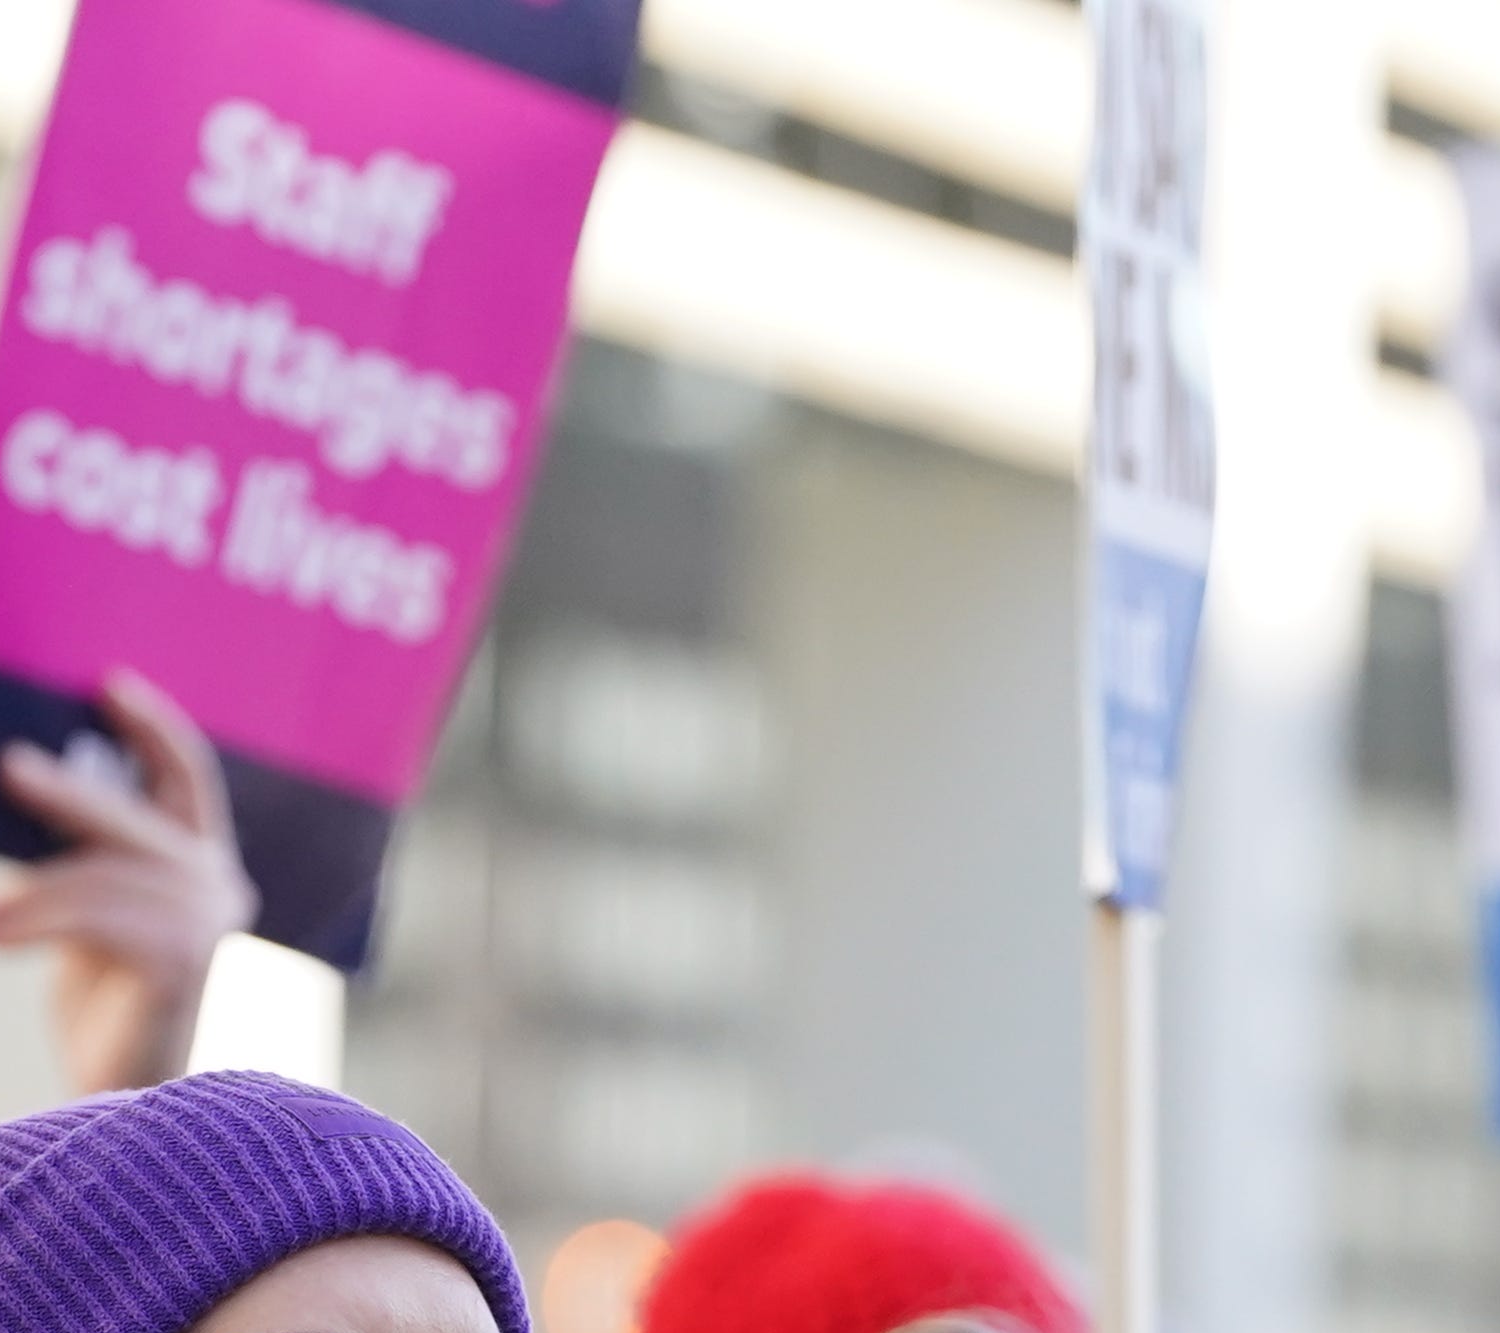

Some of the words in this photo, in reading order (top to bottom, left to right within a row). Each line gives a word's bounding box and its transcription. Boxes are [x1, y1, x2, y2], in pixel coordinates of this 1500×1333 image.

[189, 98, 452, 288] Staff
[21, 223, 515, 491] shortages
[2, 408, 222, 566] cost
[220, 457, 450, 645] lives
